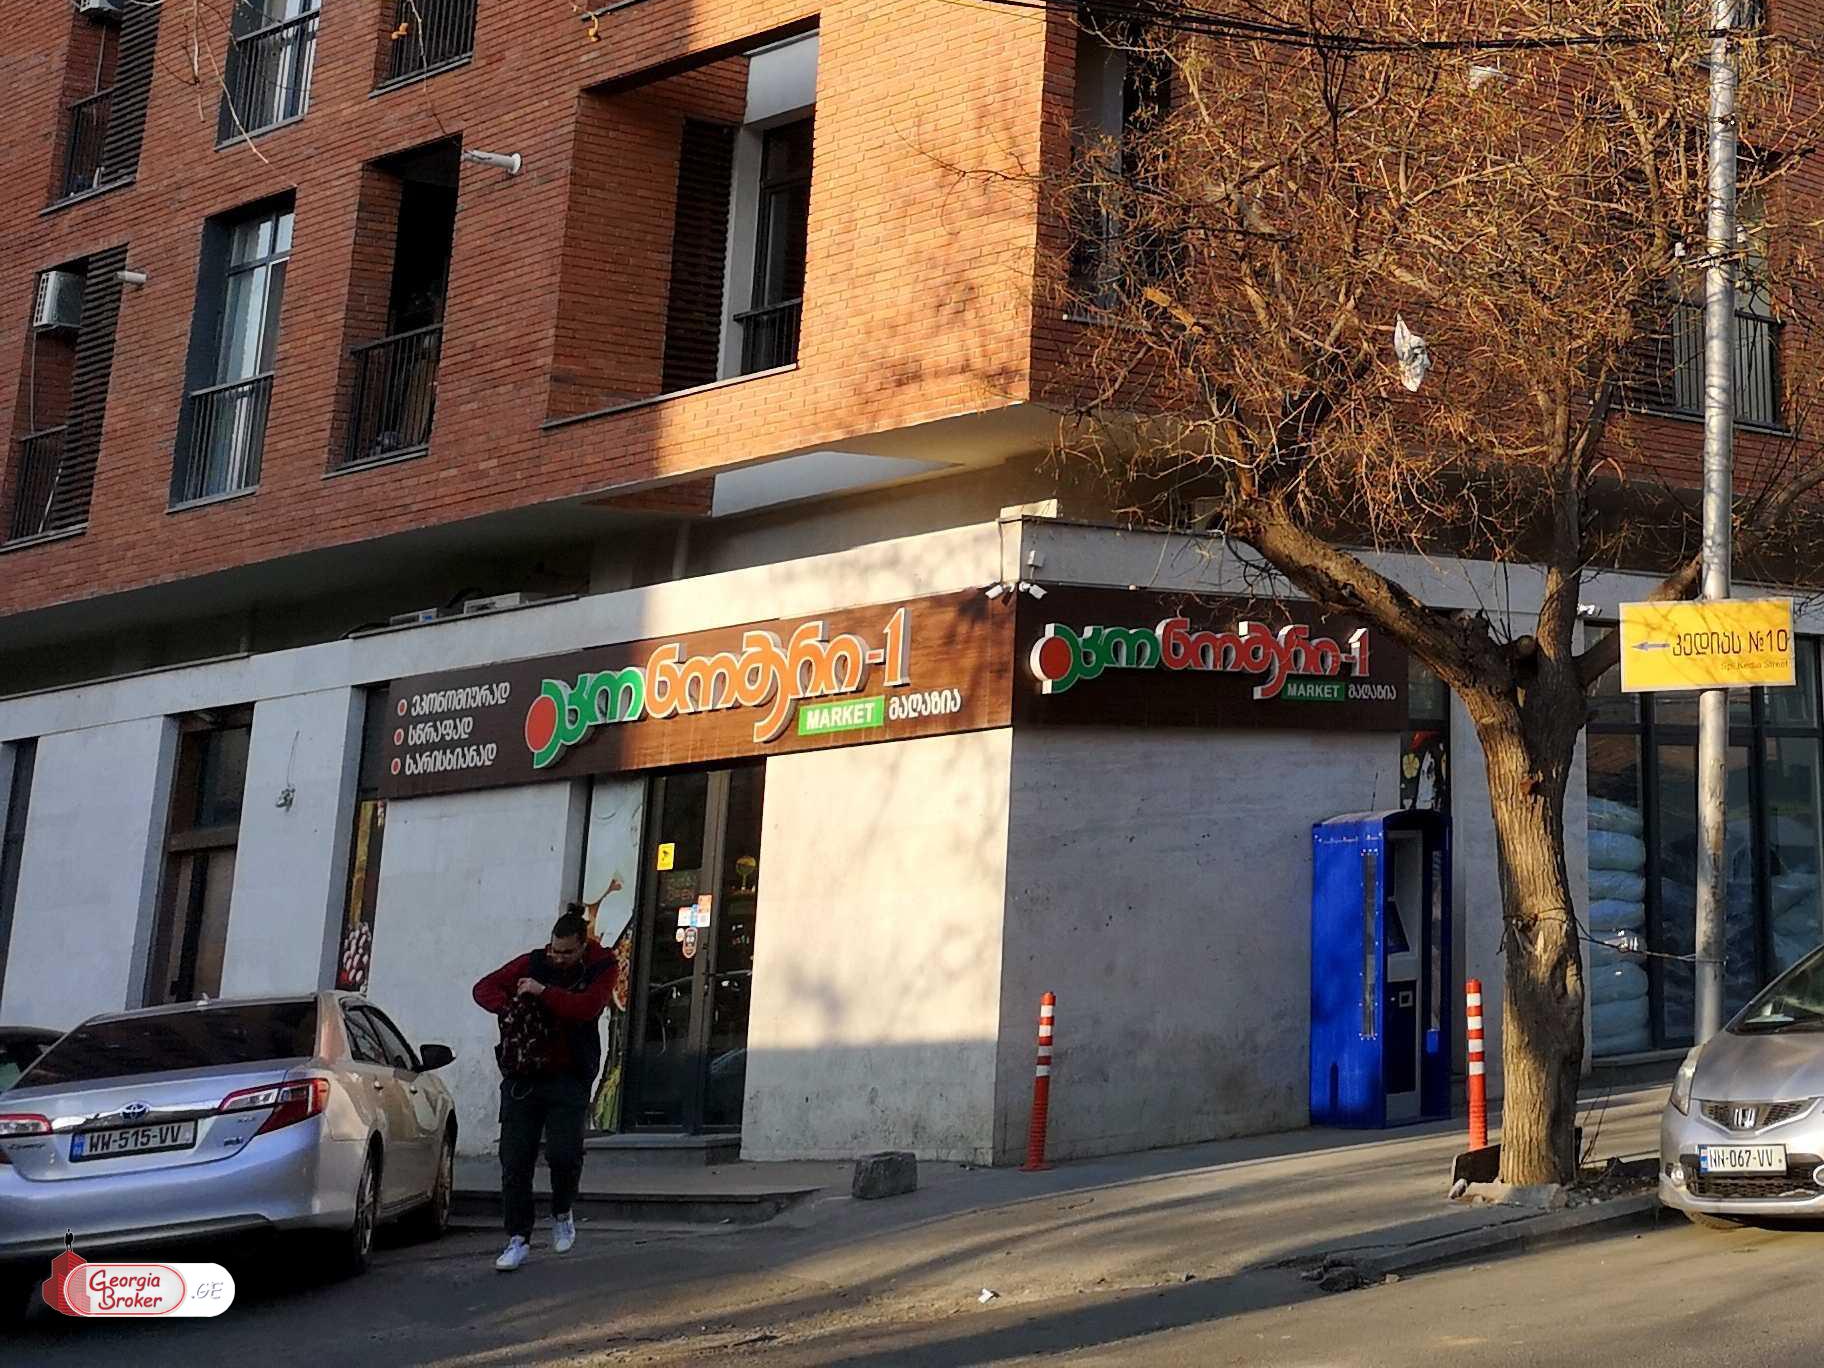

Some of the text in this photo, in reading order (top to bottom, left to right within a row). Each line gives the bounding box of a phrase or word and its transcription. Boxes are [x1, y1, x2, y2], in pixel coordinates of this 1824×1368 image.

[1673, 631, 1742, 656] კედიას
[411, 681, 510, 716] ეკონომიურად
[1287, 683, 1397, 700] MARKET მაღაზია
[806, 689, 962, 730] MARKET მაღაზია
[407, 716, 474, 746] სწრაფად
[405, 742, 497, 775] ხარისხიანად
[89, 1125, 181, 1153] WW-515-VV
[1709, 1148, 1773, 1169] NN-067-VV
